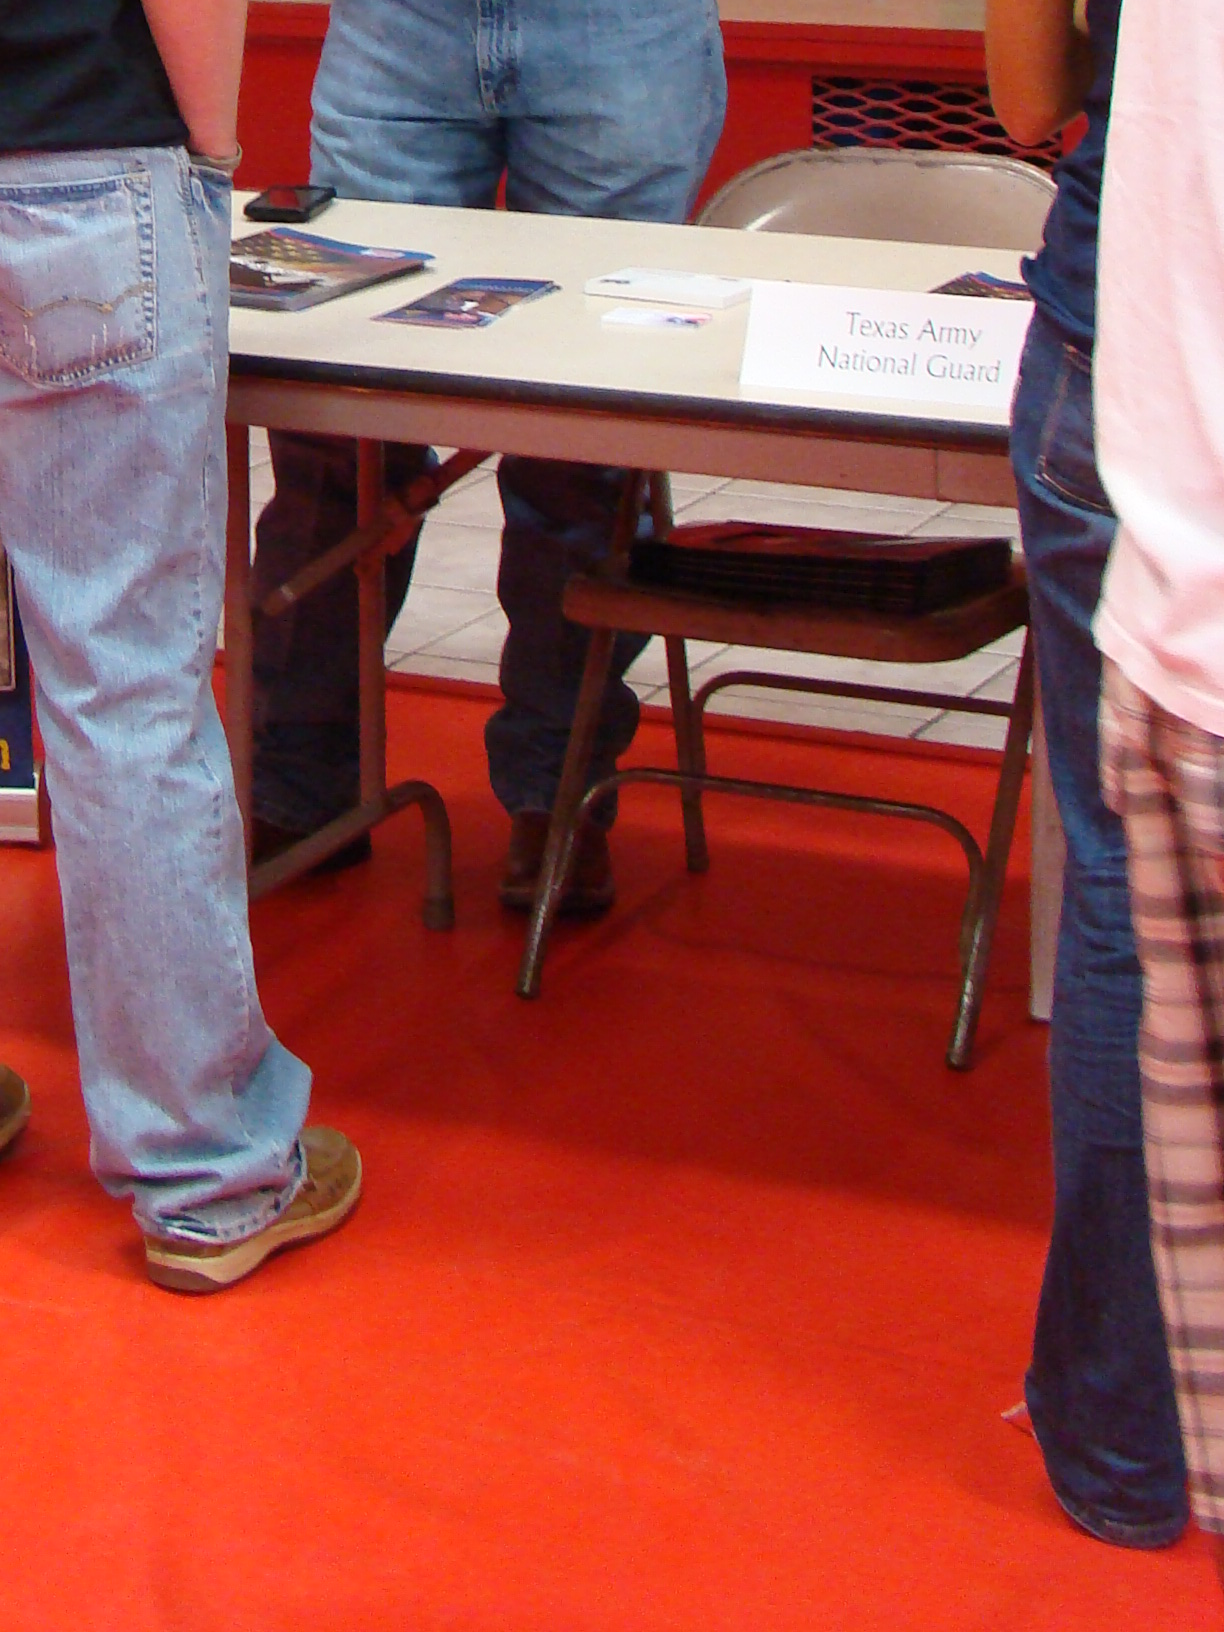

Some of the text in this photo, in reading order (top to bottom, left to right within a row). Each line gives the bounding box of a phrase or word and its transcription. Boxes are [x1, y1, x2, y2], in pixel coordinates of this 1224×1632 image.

[846, 311, 983, 347] Texas Army
[818, 344, 1002, 385] National Guard
